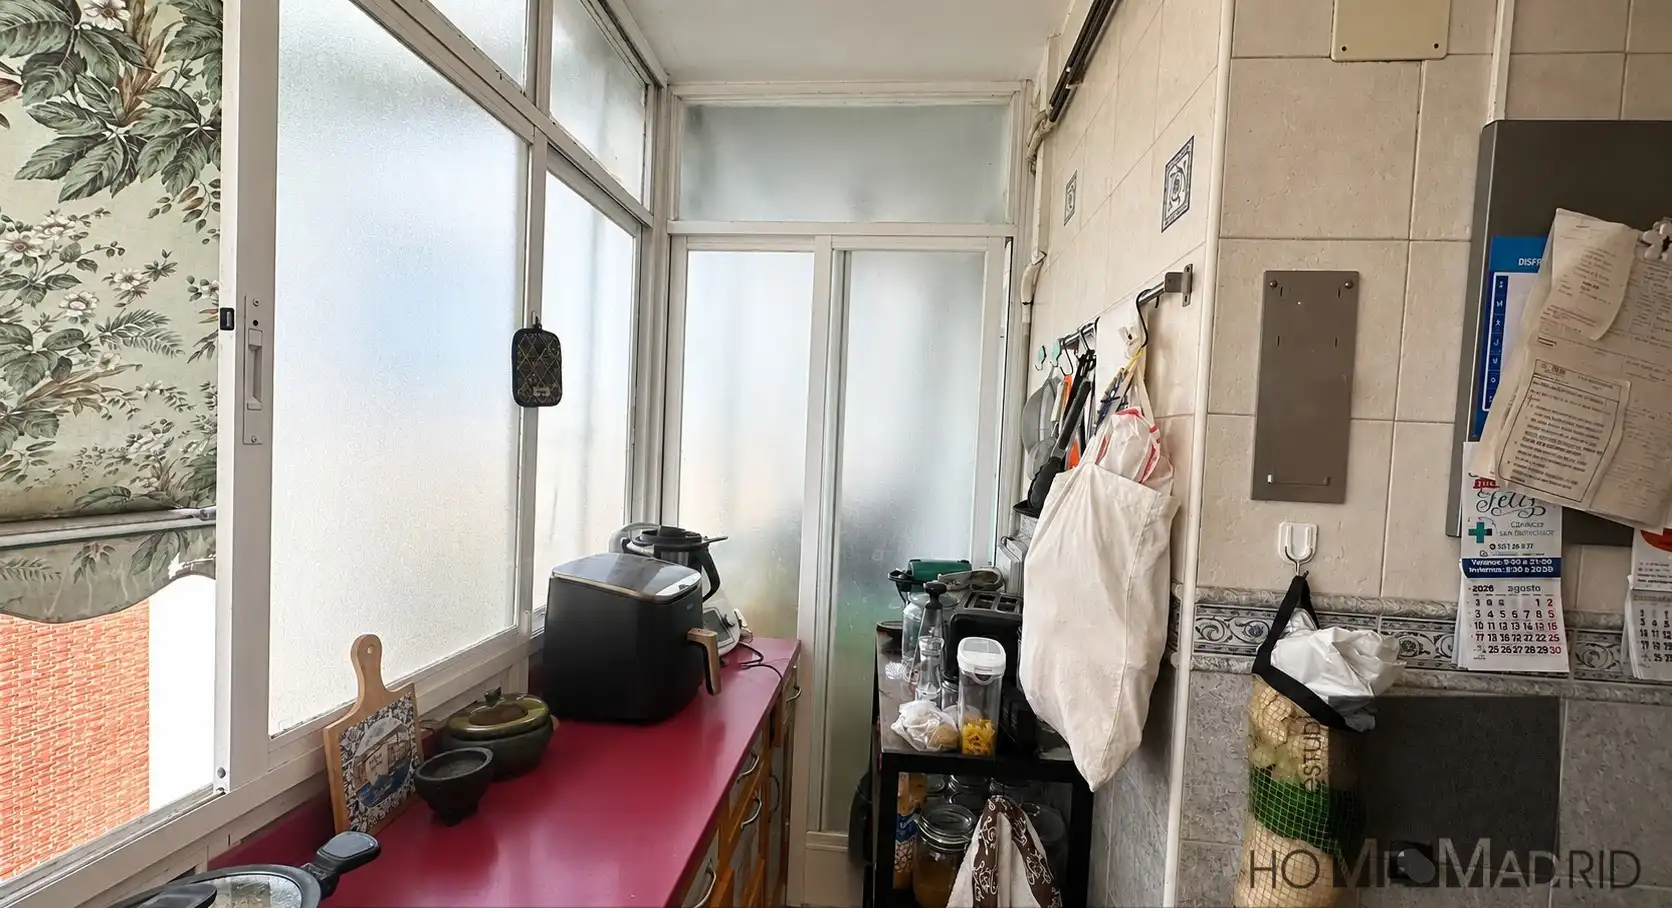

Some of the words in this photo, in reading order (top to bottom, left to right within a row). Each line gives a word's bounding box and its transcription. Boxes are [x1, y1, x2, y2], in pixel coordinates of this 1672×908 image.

[1507, 585, 1541, 593] agosto
[1475, 610, 1481, 618] 3
[1487, 610, 1494, 618] 4
[1500, 610, 1506, 618] 5
[1512, 610, 1518, 618] 6
[1523, 610, 1530, 618] 7
[1475, 622, 1483, 630] 10
[1487, 622, 1495, 630] 11
[1488, 646, 1499, 654] 25
[1500, 646, 1512, 654] 26
[1525, 646, 1535, 654] 28
[1537, 646, 1548, 654] 29
[1550, 646, 1561, 654] 30
